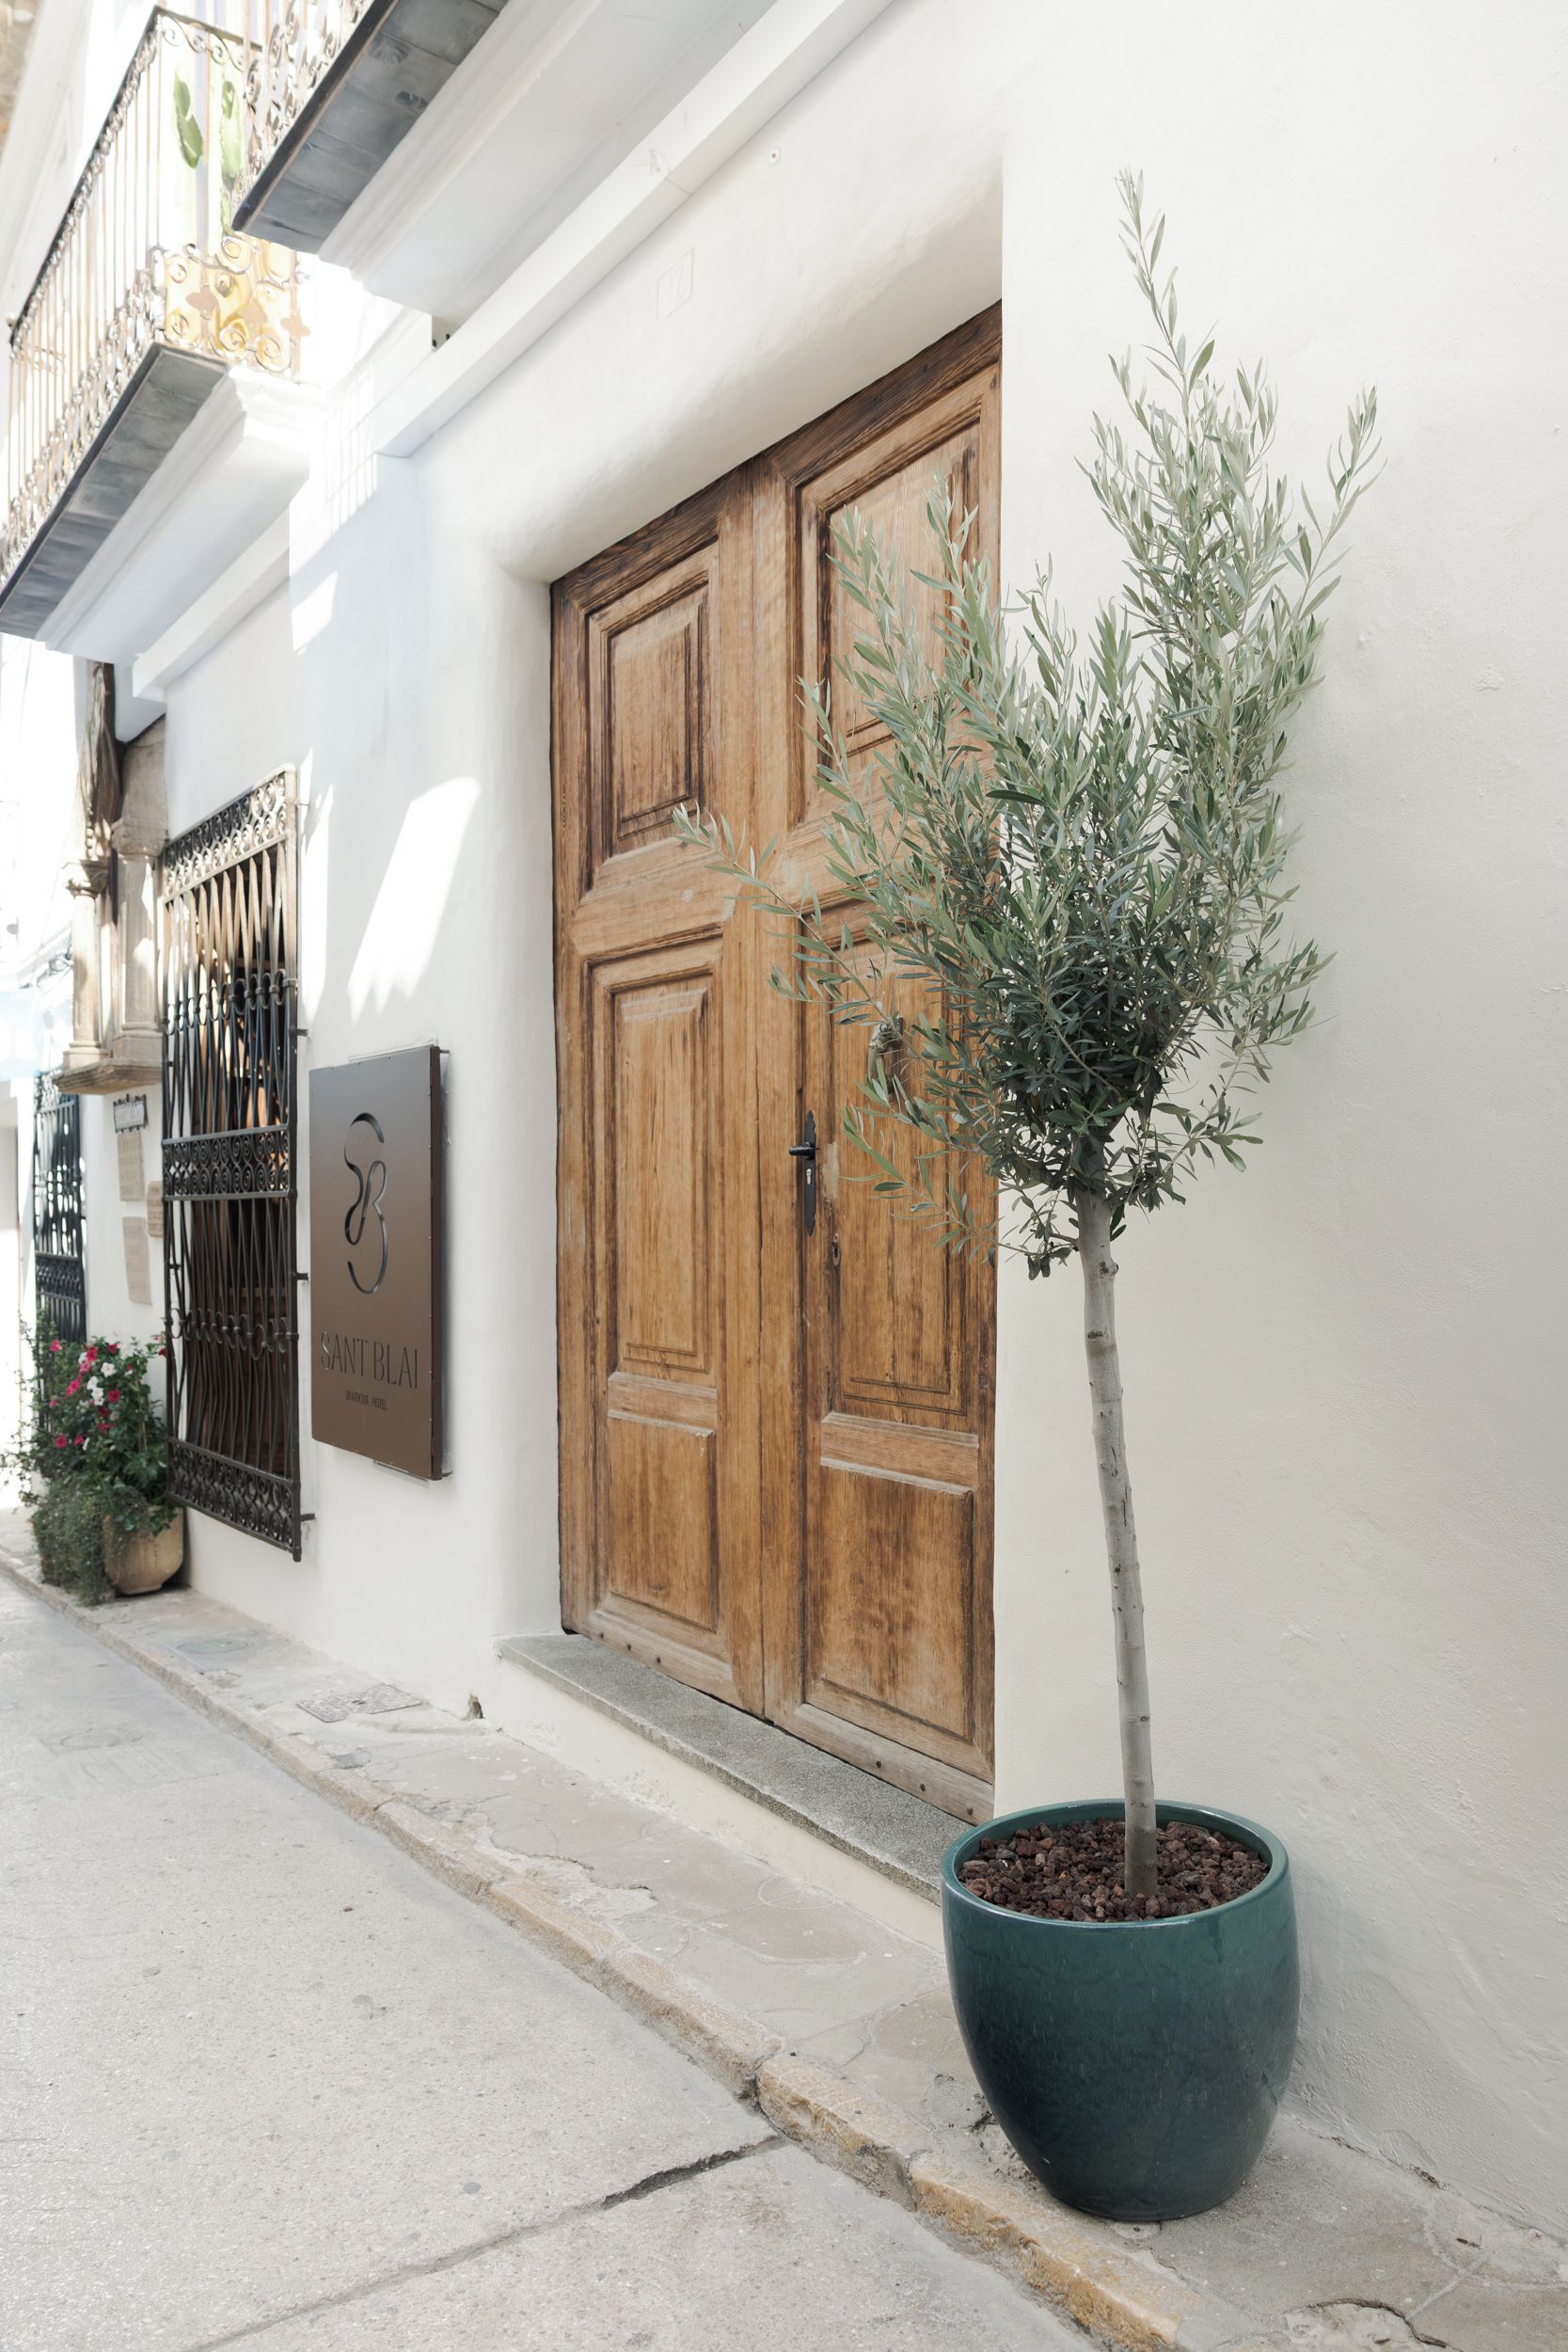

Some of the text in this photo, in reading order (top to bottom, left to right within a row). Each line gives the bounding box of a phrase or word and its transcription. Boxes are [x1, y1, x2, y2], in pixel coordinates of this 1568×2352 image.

[321, 1331, 418, 1390] SANT BLAI
[346, 1390, 388, 1411] BOUTIQUE HOTEL
